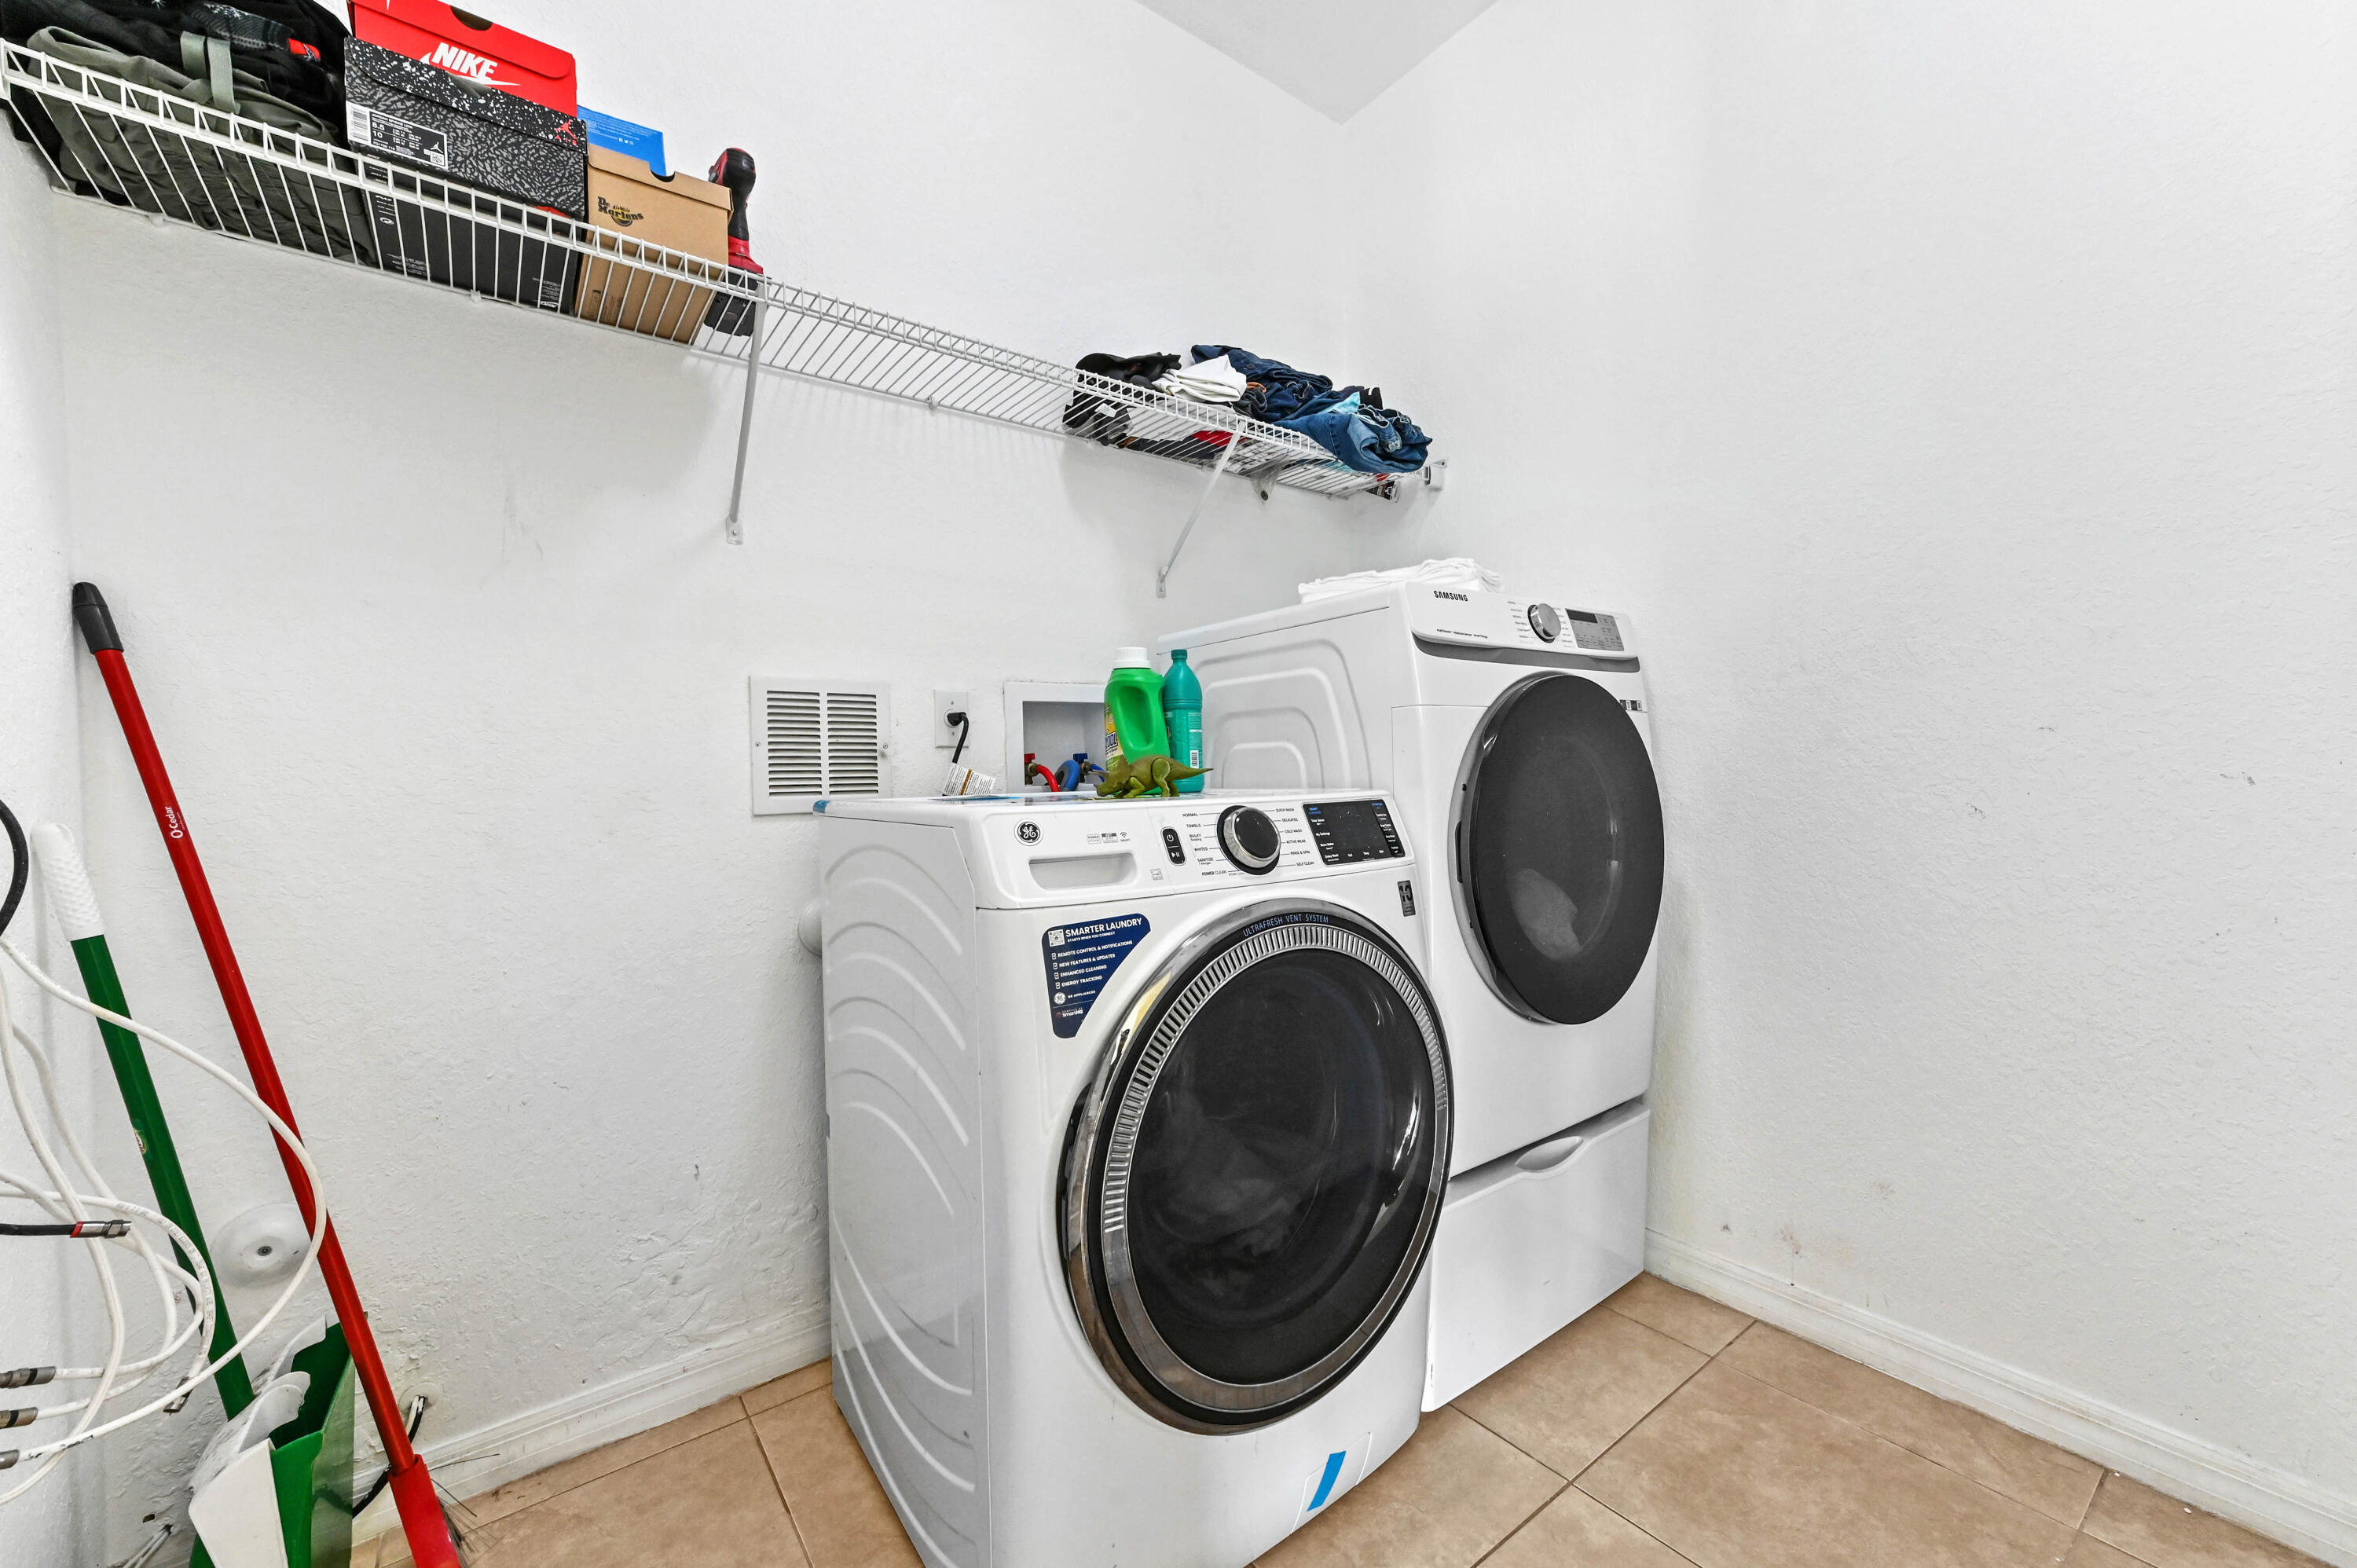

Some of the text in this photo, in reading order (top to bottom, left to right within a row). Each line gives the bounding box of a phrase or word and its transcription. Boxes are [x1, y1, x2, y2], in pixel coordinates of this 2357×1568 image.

[431, 42, 498, 81] NIKE
[372, 121, 385, 131] 8.5
[372, 130, 383, 139] 10
[598, 204, 644, 221] Martens
[1434, 591, 1468, 602] SAMSUNG
[1065, 918, 1142, 937] SMARTER LAUNDRY
[1243, 914, 1329, 936] ULTRAFRESH VENT SYSTEM
[1076, 947, 1097, 955] CONTROL
[1102, 940, 1133, 950] NOTIFICATIONS
[1086, 965, 1107, 973] CLEANING
[1080, 975, 1102, 984] TRACKING
